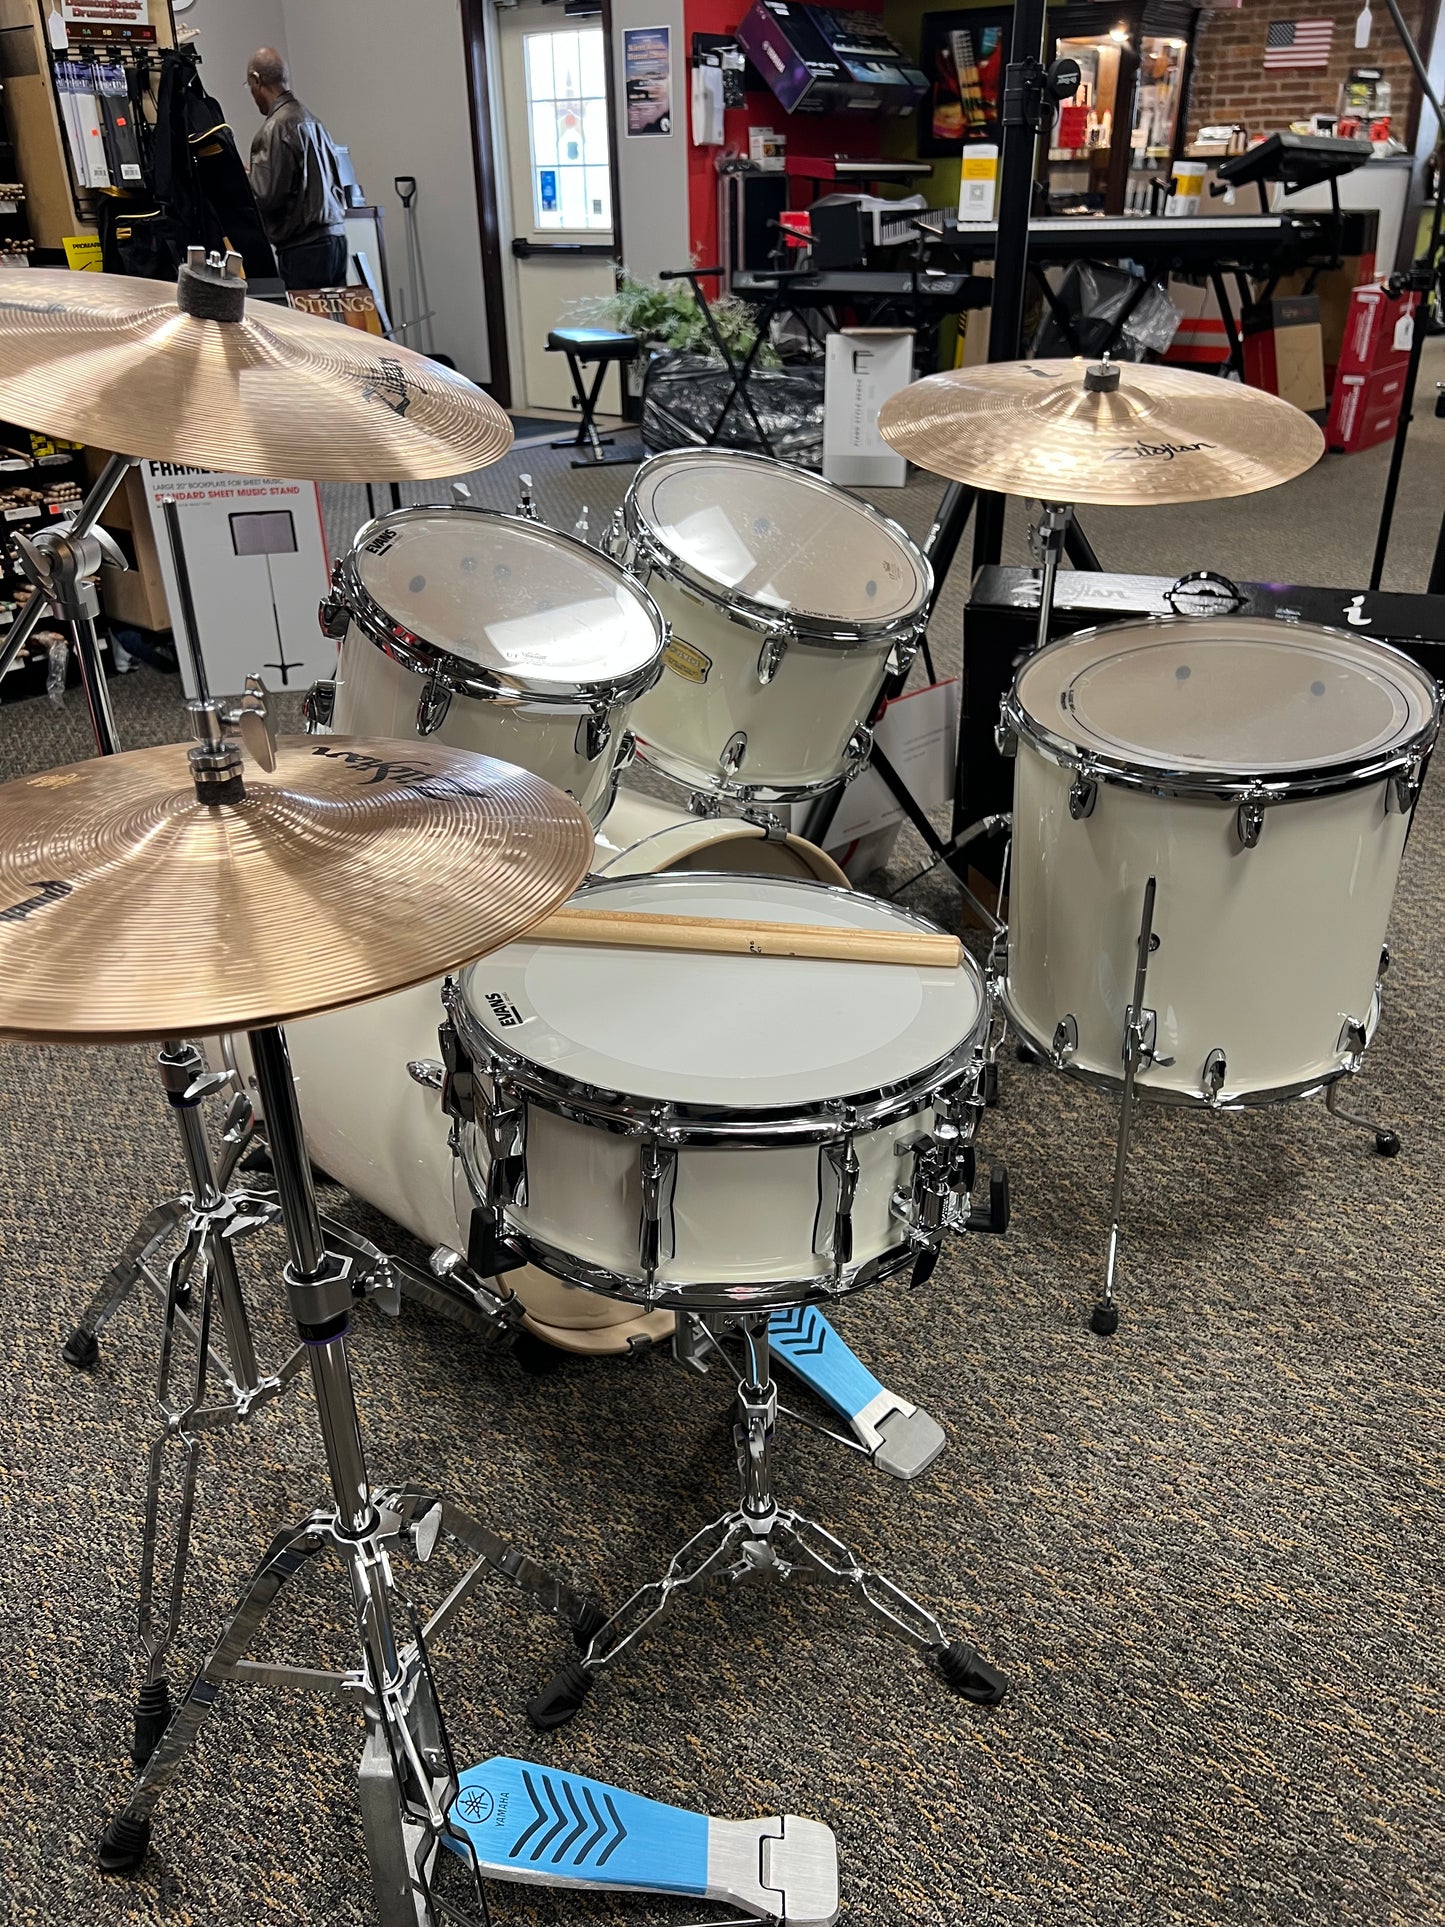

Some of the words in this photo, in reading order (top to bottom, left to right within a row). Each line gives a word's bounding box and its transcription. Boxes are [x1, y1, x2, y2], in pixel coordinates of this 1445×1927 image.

[294, 296, 376, 313] STRINGS
[1103, 440, 1217, 461] Zildjian
[153, 482, 175, 491] LARGE
[227, 479, 242, 487] FOR
[208, 489, 234, 498] SHEET
[237, 487, 267, 497] MUSIC
[270, 486, 300, 495] STAND
[365, 529, 397, 554] EVANS
[484, 993, 517, 1027] EVANS
[495, 1792, 510, 1827] YAMAHA
